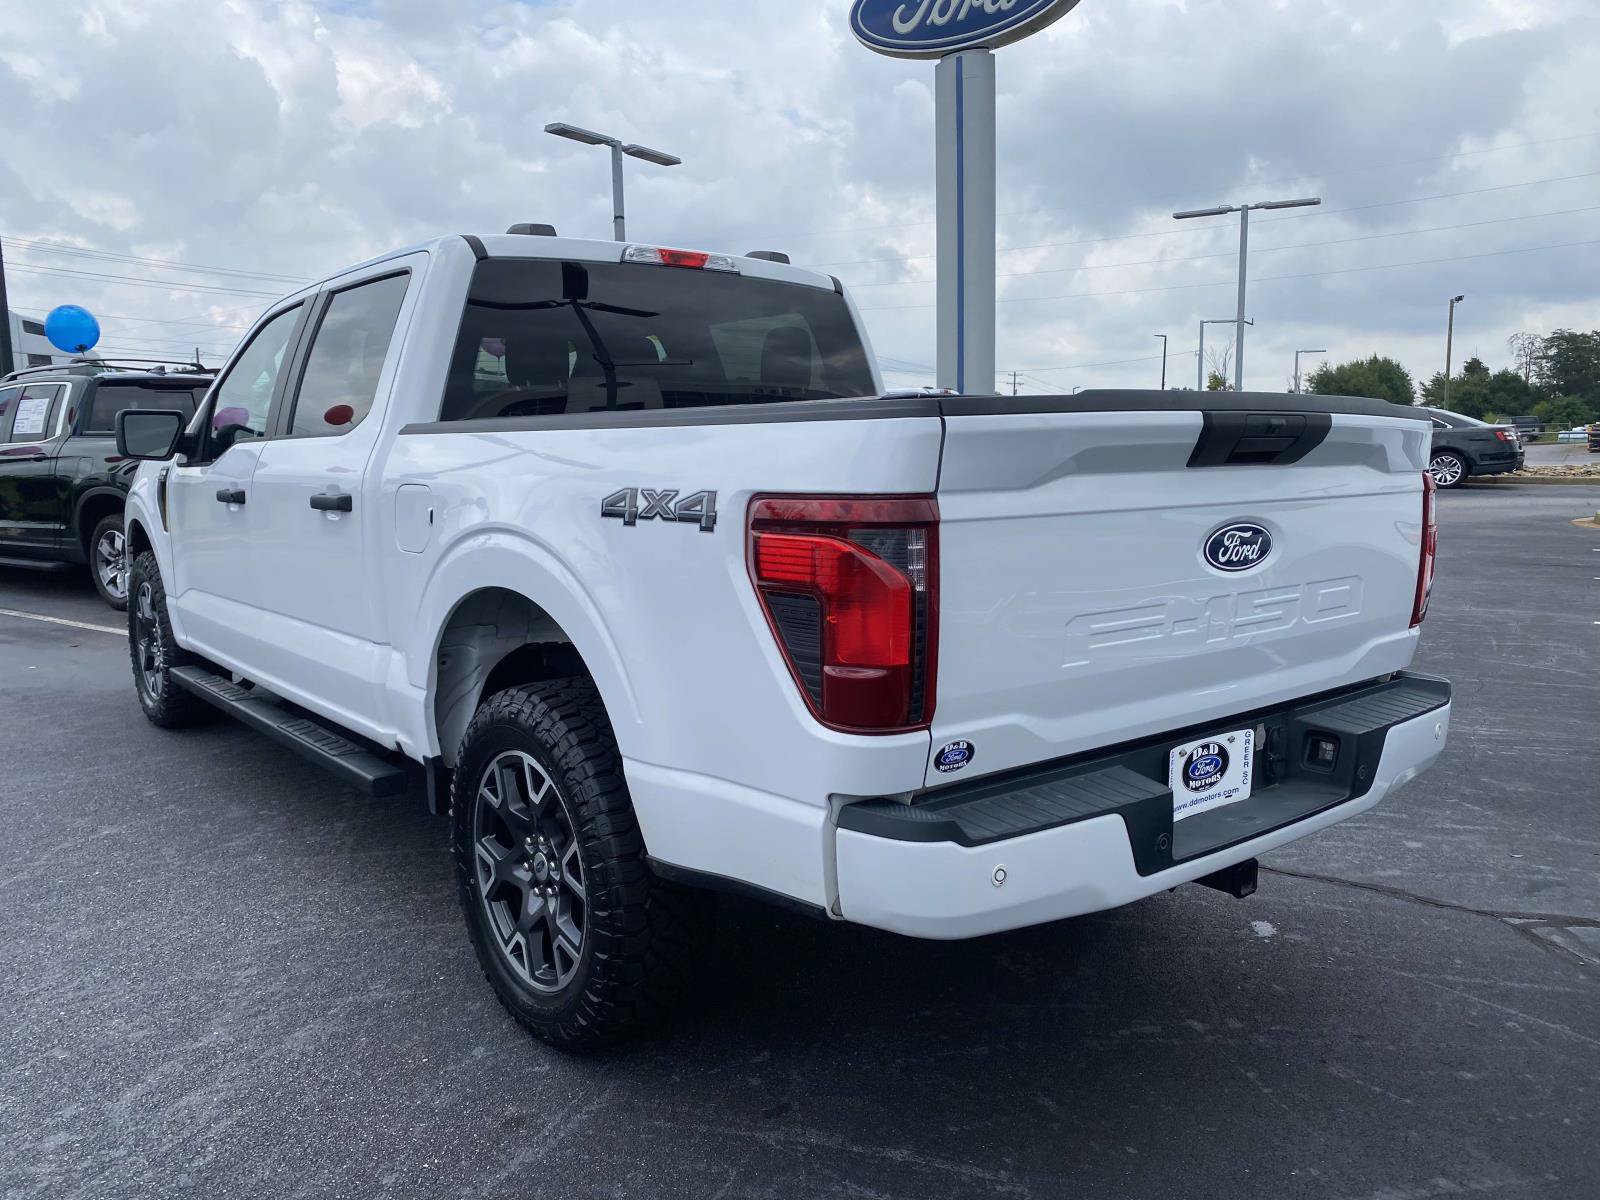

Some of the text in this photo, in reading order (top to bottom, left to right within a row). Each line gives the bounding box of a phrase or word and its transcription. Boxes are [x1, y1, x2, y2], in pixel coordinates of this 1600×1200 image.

[892, 0, 1017, 35] or
[1218, 530, 1263, 563] Ford
[1192, 743, 1219, 761] D&D
[1242, 731, 1251, 784] GREER SC
[1195, 759, 1216, 775] Ford
[1189, 772, 1221, 788] MOTORS
